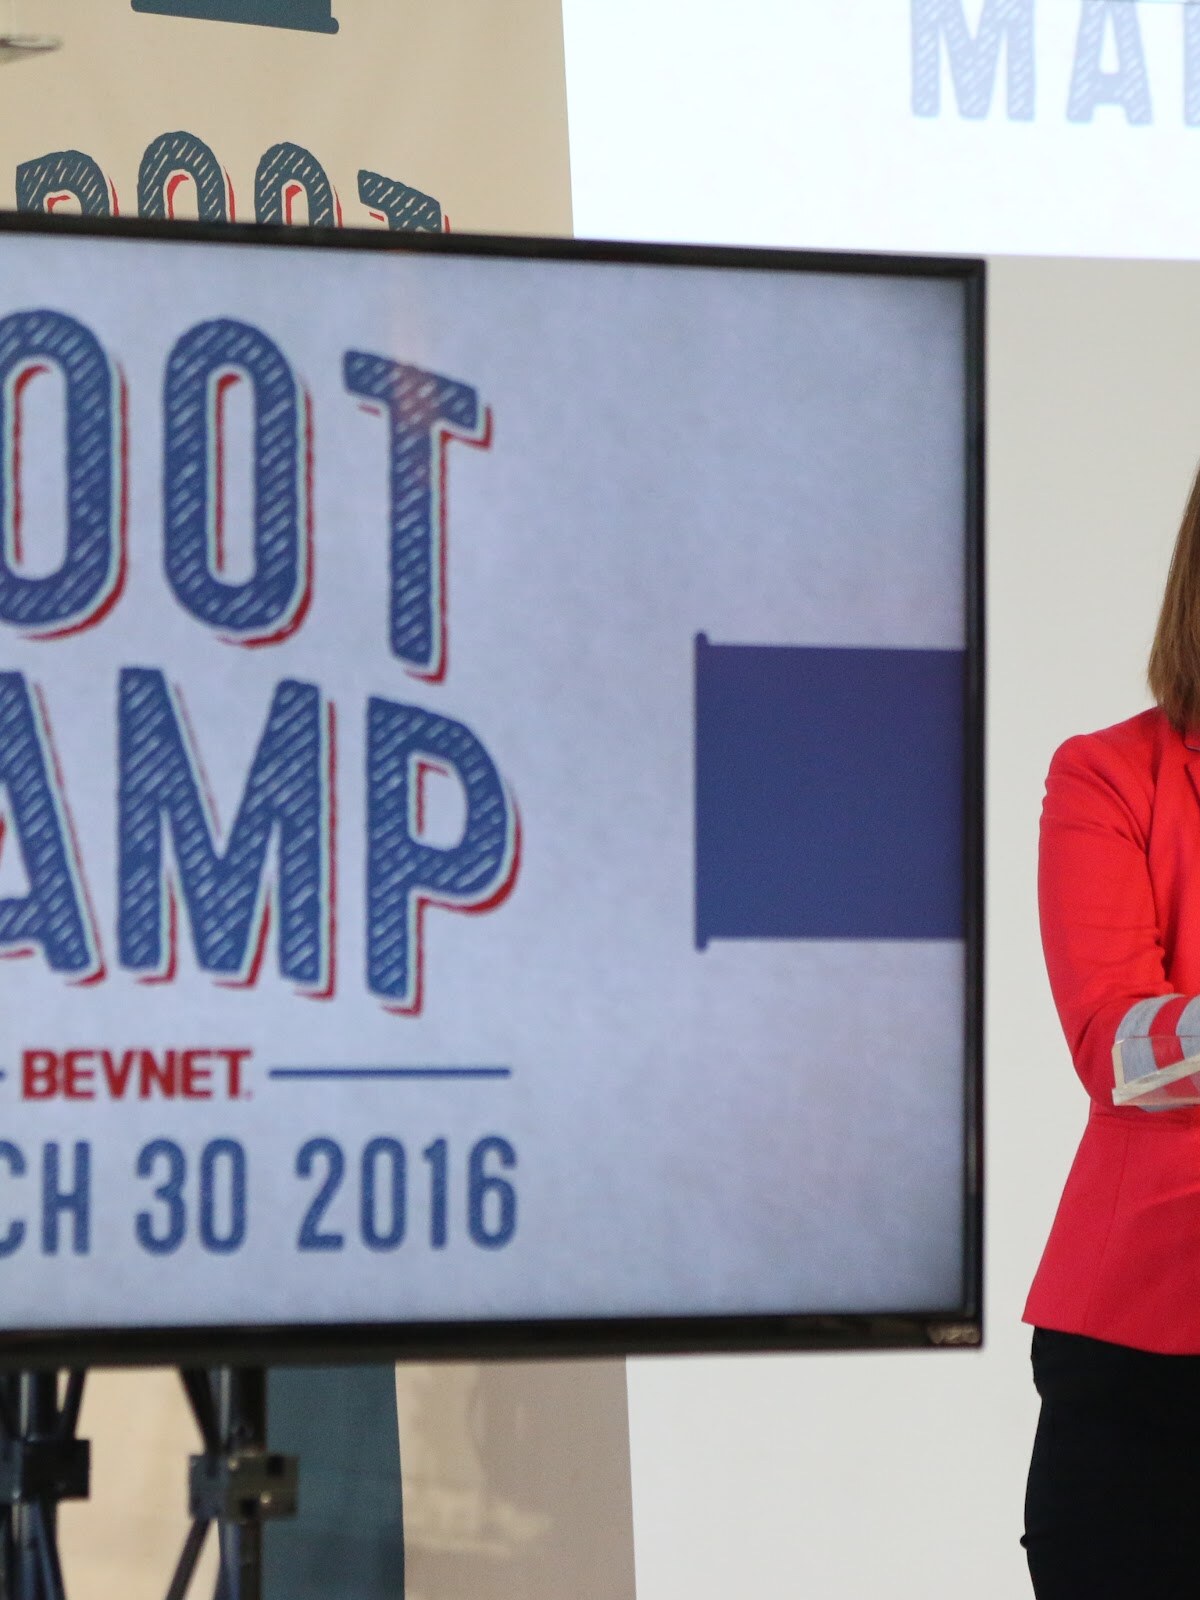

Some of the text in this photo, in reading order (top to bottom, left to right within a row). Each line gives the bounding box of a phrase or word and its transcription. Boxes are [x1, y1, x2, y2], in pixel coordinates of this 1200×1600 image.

[22, 1048, 253, 1100] BEVNET
[136, 1136, 248, 1256] 30
[295, 1135, 519, 1253] 2016
